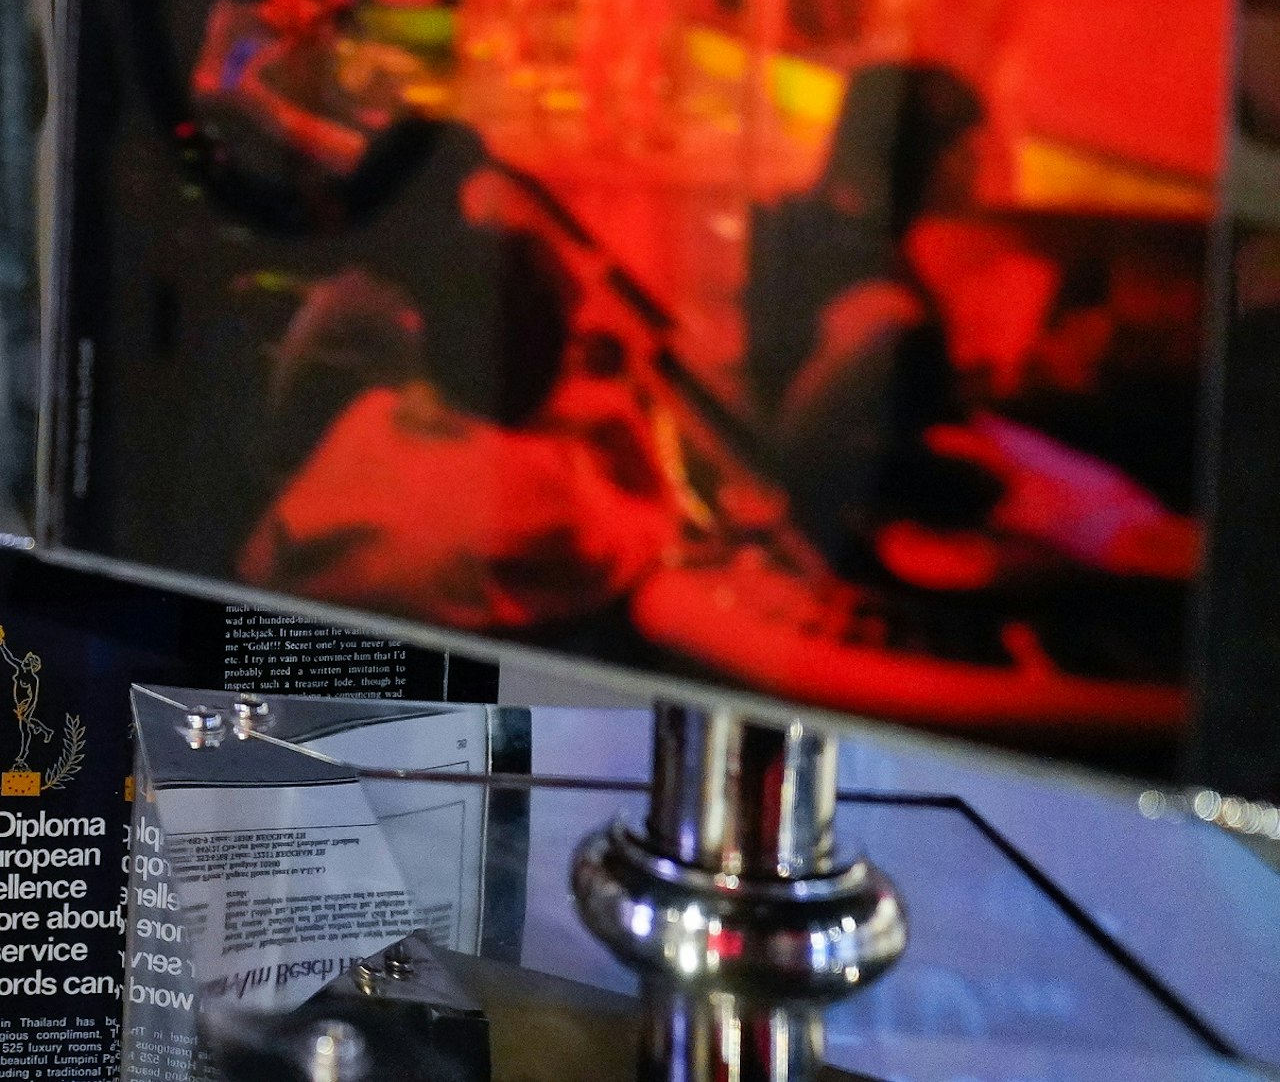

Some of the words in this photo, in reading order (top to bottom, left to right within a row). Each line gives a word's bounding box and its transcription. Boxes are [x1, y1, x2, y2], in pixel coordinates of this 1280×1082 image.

[226, 617, 242, 625] wad
[246, 616, 256, 625] of
[233, 629, 276, 639] blackjack.
[314, 628, 329, 636] out
[331, 627, 342, 635] he
[285, 642, 312, 650] Secret
[340, 640, 357, 649] you
[361, 640, 384, 648] never
[225, 656, 241, 664] etc.
[252, 655, 264, 665] try
[268, 654, 276, 663] in
[280, 654, 298, 662] vain
[302, 654, 311, 662] to
[314, 653, 352, 662] convince
[354, 652, 371, 661] him
[374, 651, 390, 660] that
[393, 650, 406, 659] I'd
[224, 668, 263, 679] probably
[270, 667, 290, 676] need
[310, 667, 341, 675] written
[348, 665, 390, 674] invitation
[224, 681, 255, 690] inspect
[260, 680, 279, 688] such
[295, 679, 328, 688] treasure
[361, 677, 391, 687] though
[395, 677, 406, 685] he
[1, 1019, 11, 1028] in
[20, 1018, 67, 1027] Thailand
[76, 1017, 95, 1027] has
[36, 1029, 103, 1040] compliment.
[2, 1043, 23, 1053] 525
[28, 1042, 62, 1053] luxury
[68, 1043, 102, 1052] rooms
[0, 1054, 48, 1065] beautiful
[54, 1054, 98, 1065] Lumpini
[35, 1070, 42, 1078] a
[47, 1067, 101, 1077] traditional
